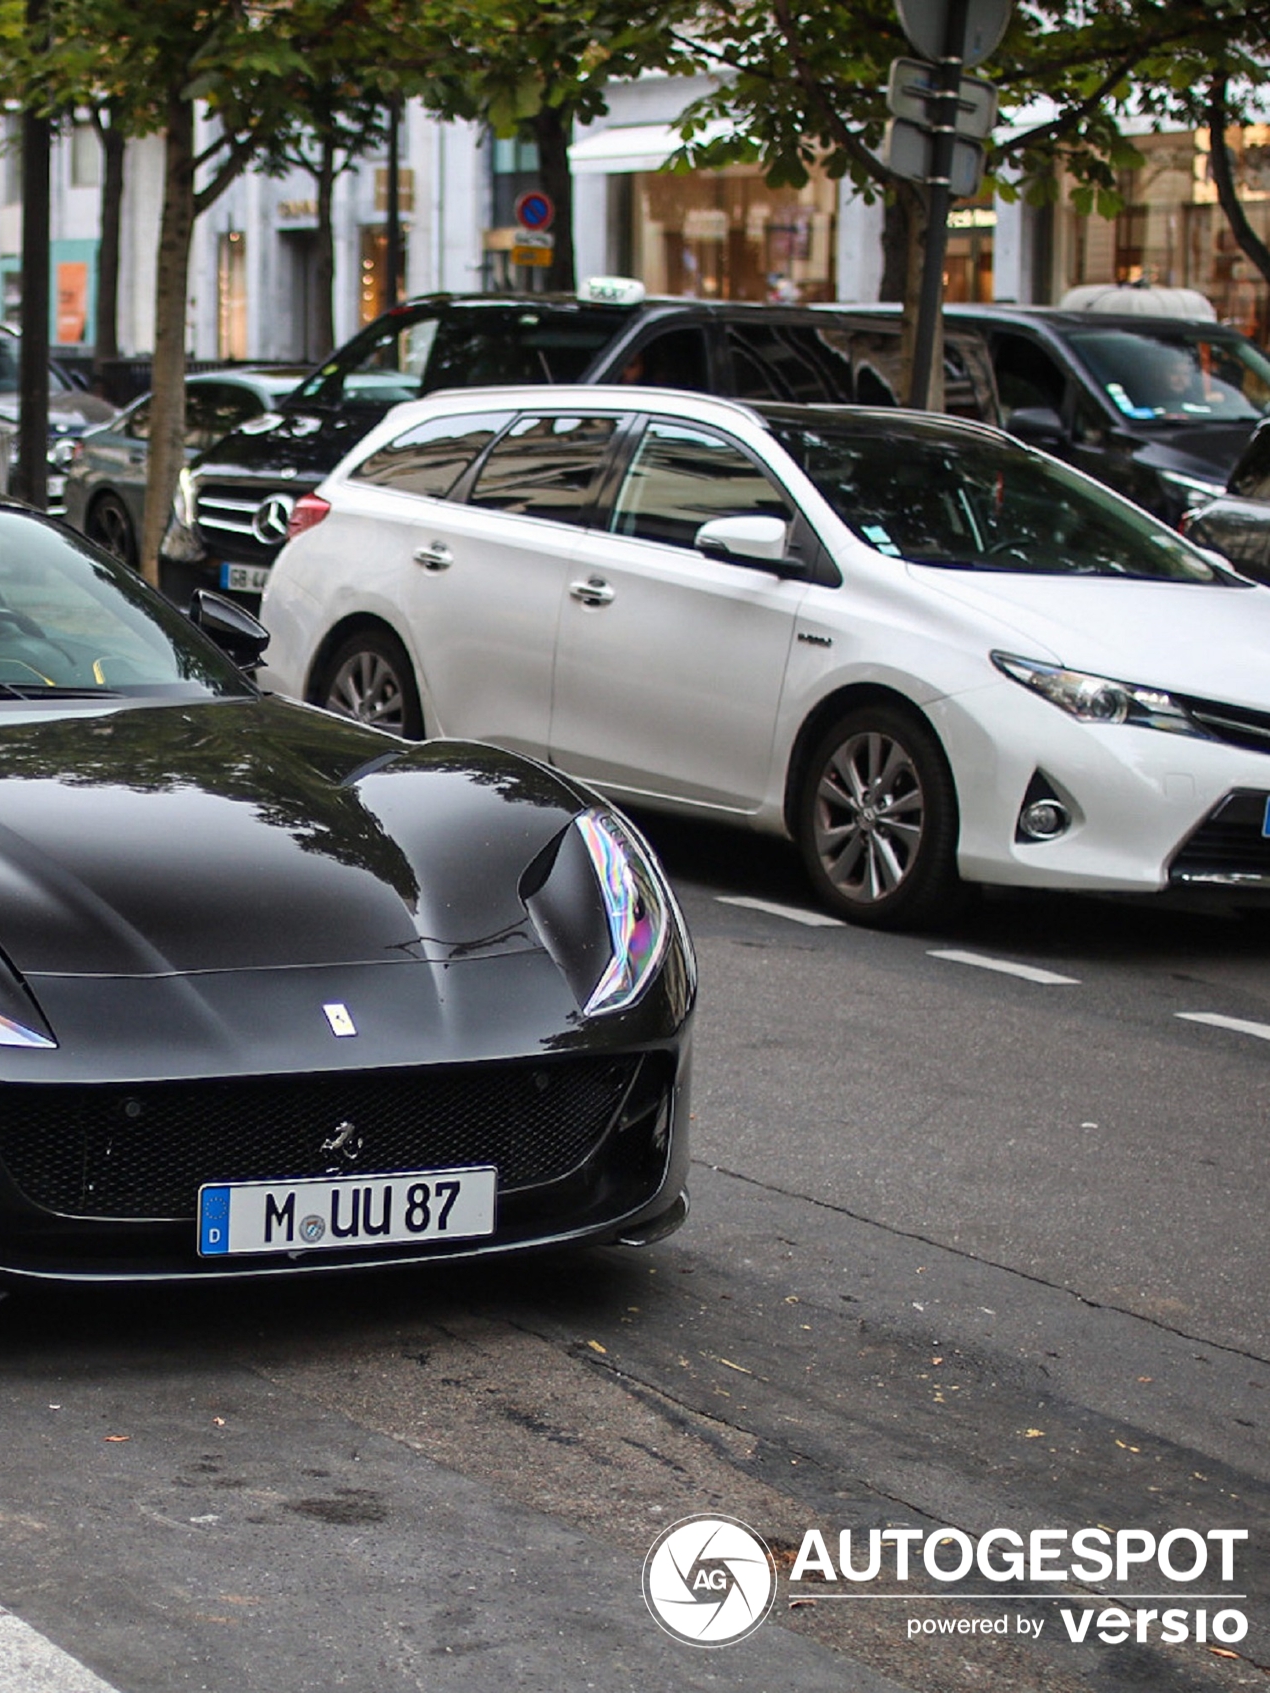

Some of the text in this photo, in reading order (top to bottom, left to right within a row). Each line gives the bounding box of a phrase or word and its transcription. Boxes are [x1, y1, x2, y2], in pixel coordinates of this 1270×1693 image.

[264, 1180, 461, 1243] M UU 87
[209, 1229, 221, 1243] D
